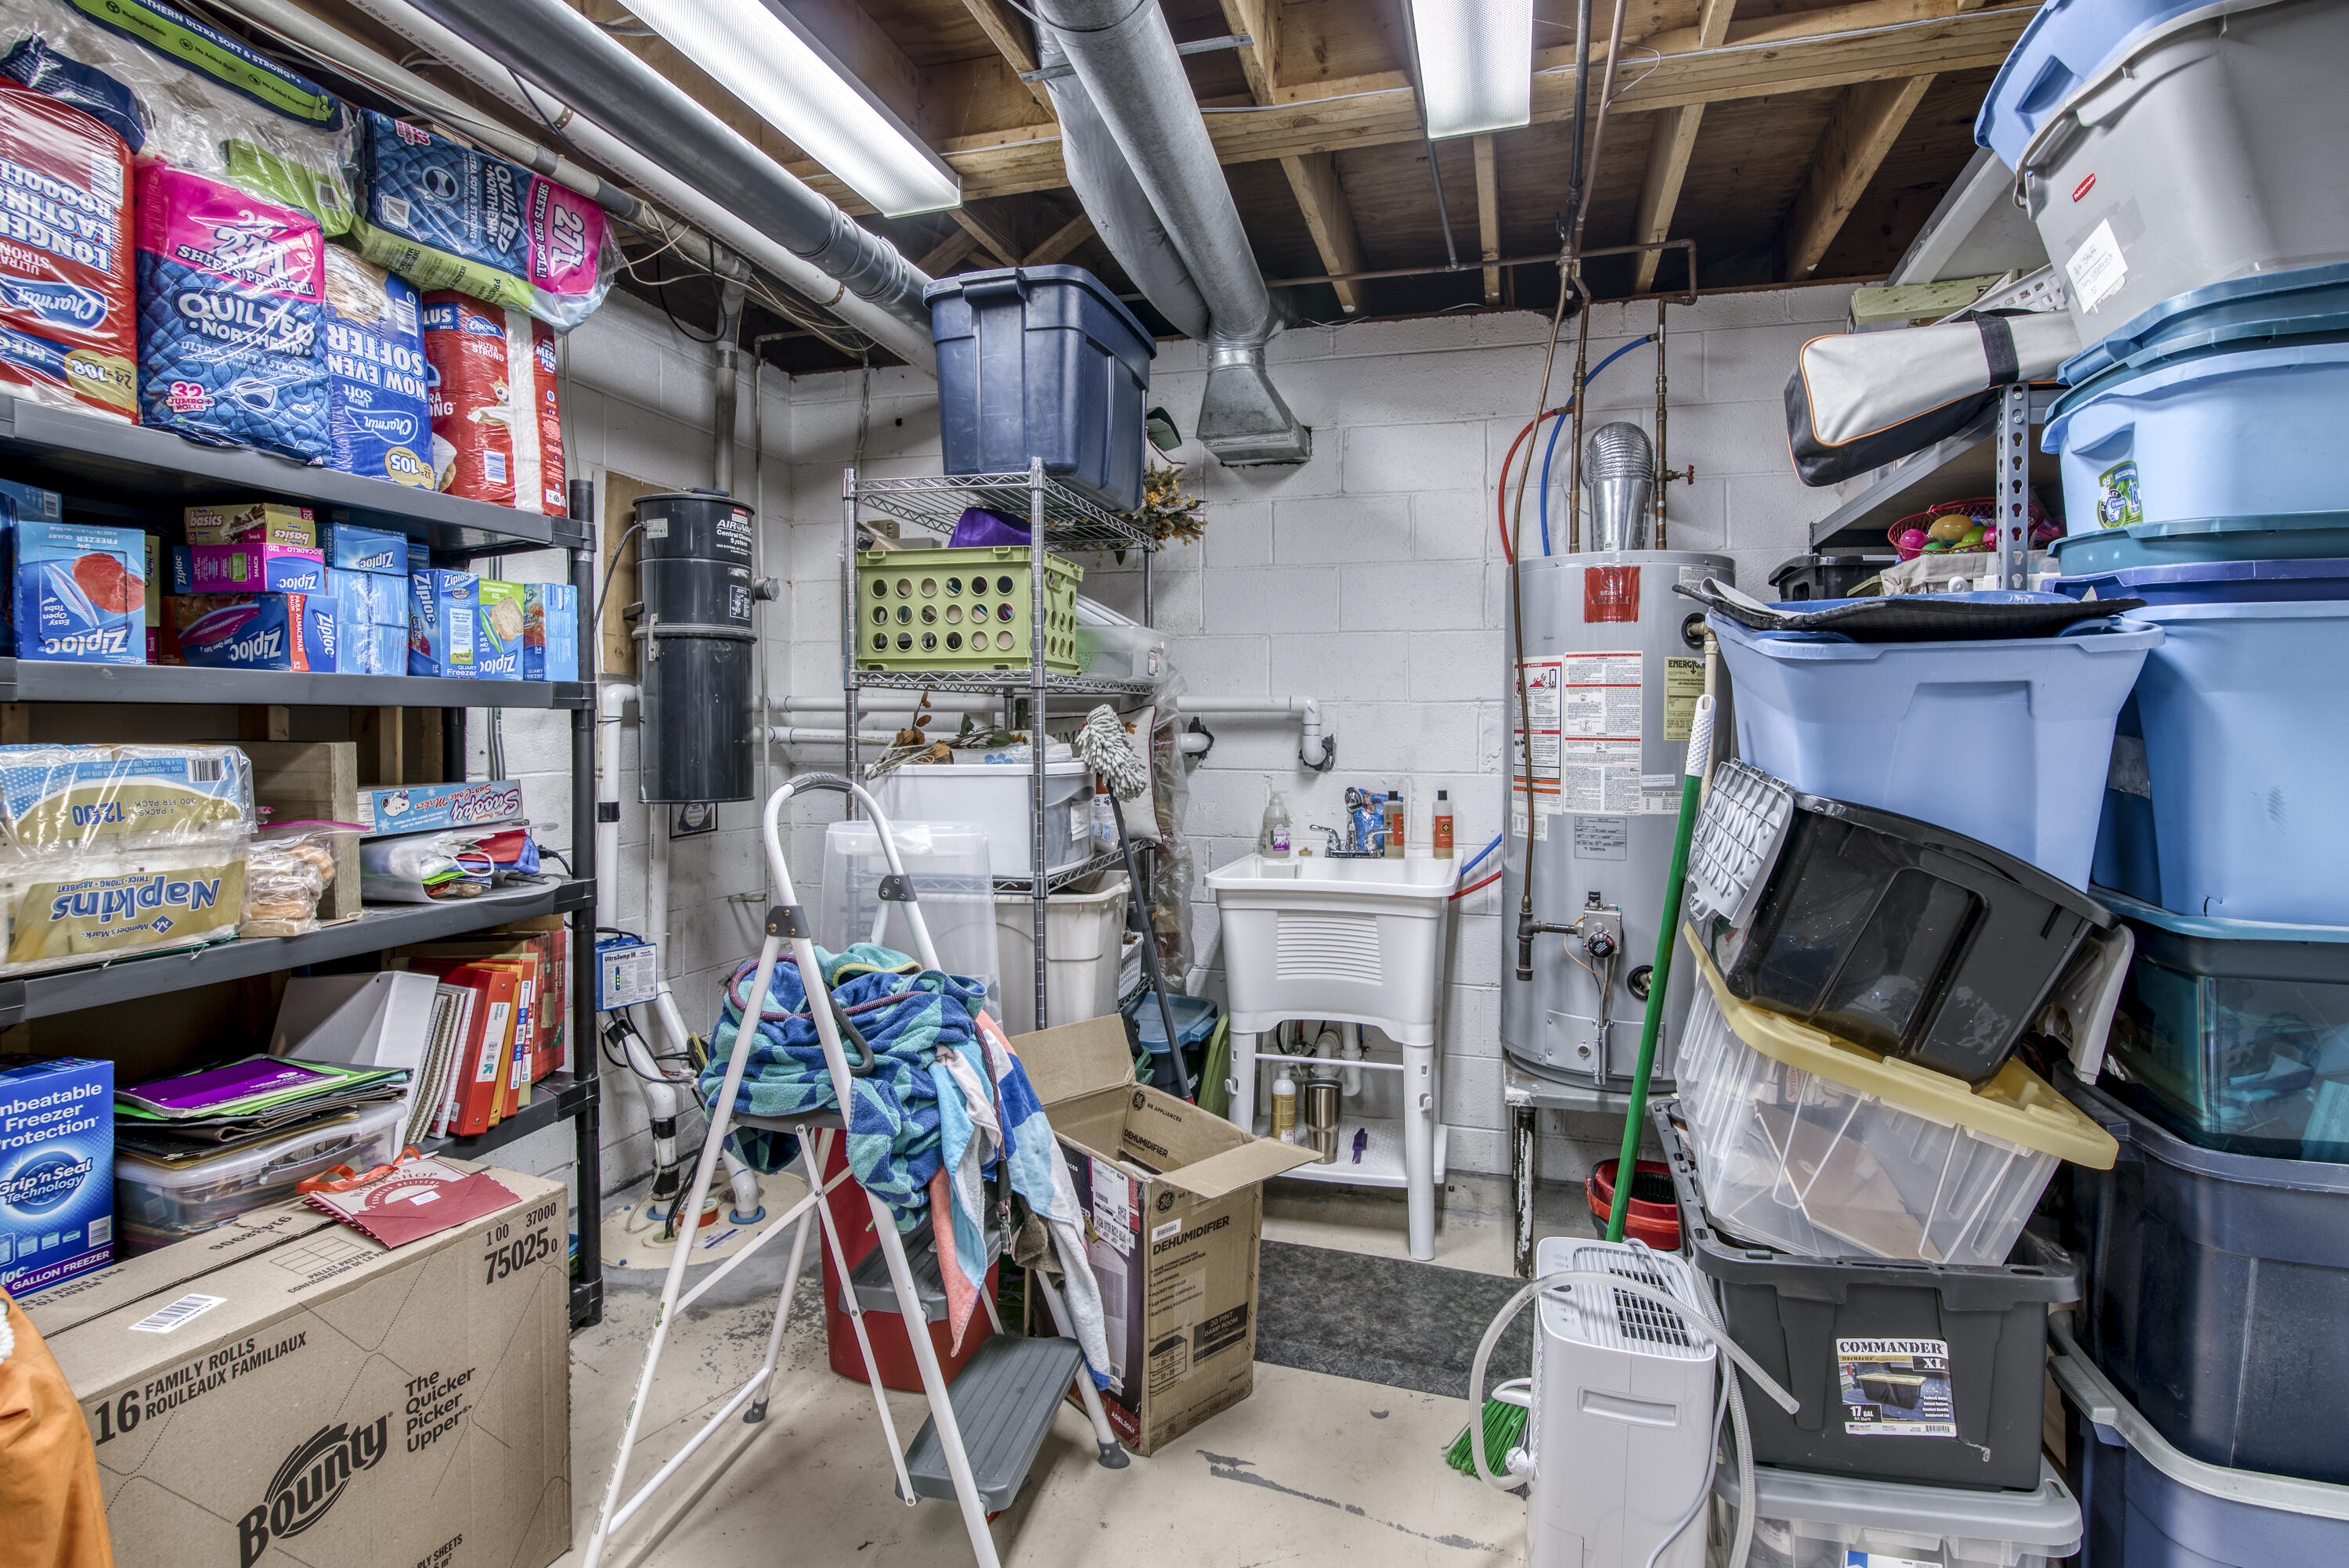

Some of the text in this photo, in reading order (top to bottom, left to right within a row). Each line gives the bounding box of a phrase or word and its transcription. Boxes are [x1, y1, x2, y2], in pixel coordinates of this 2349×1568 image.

[121, 9, 167, 37] Biodegradable
[185, 19, 216, 40] ULTRA
[218, 36, 243, 54] SOFT
[194, 45, 222, 67] No Added
[413, 128, 430, 145] 32
[469, 153, 478, 175] ULTRA
[2073, 175, 2096, 199] Rubbermaid
[494, 165, 513, 254] QUILTED
[534, 182, 550, 279] SHEETS PER ROLL!
[551, 205, 584, 267] 271
[175, 244, 276, 289] SHEETS PER
[18, 288, 98, 322] Charmin
[178, 291, 315, 346] QUILTED
[469, 319, 497, 334] Charmin
[181, 341, 259, 364] ULTRA SOFT
[327, 321, 425, 377] SOFTER
[471, 344, 505, 362] STRONG
[477, 340, 498, 352] ULTRA
[73, 358, 109, 384] 108
[327, 353, 428, 402] NOW EVEN
[343, 384, 373, 402] Soft
[348, 397, 370, 409] Ultra
[363, 415, 412, 437] Charmin
[391, 453, 420, 474] 105
[2127, 482, 2140, 506] 18
[189, 510, 222, 528] basics
[75, 535, 119, 545] FREEZER
[273, 529, 311, 545] basics
[716, 529, 738, 539] Central
[730, 537, 748, 547] System
[287, 546, 323, 556] BOCADILLO
[359, 551, 394, 570] Ziploc
[175, 555, 188, 586] Ziploc
[278, 574, 317, 591] Ziploc
[444, 573, 470, 588] Ziploc
[413, 573, 435, 623] Ziploc
[44, 628, 128, 657] Ziploc
[212, 637, 234, 651] Easy Open
[295, 612, 304, 652] ALMACENAR
[315, 611, 336, 656] Ziploc
[229, 630, 282, 661] Ziploc
[293, 661, 301, 670] 52
[446, 668, 478, 676] Freezer
[414, 784, 492, 810] Sno-Cone Maker
[450, 789, 520, 822] Snoopy
[49, 876, 221, 923] Napkins
[110, 922, 149, 934] Member's
[604, 953, 630, 962] UltraSump
[5, 1105, 84, 1133] Freezer
[1154, 1105, 1182, 1123] APPLIANCES
[1123, 1128, 1169, 1159] DEHUMIDIFIER
[0, 1159, 92, 1196] Grip'n Seal
[5, 1176, 85, 1205] Technology
[371, 1179, 441, 1206] EXPRESS DELIVERY
[525, 1202, 557, 1228] 37000
[1153, 1215, 1230, 1256] DEHUMIDIFIER
[307, 1250, 374, 1280] PALLET PATTERN
[484, 1227, 549, 1286] 75025
[1165, 1256, 1189, 1268] CONNECTION
[1177, 1252, 1207, 1270] DRAIN OPTION
[11, 1250, 110, 1291] GALLON FREEZER
[287, 1256, 373, 1295] CONFIGURATION DE LA
[1156, 1272, 1179, 1286] FAN SPEEDS
[1151, 1290, 1203, 1317] EASY-ROLL WHEELS
[1152, 1287, 1167, 1297] POCKET
[1159, 1284, 1196, 1304] DIGITAL CONTROLS
[1203, 1316, 1239, 1339] DAMP ROOM
[1210, 1310, 1234, 1328] 20 PINT
[1839, 1340, 1943, 1355] COMMANDER
[145, 1337, 256, 1401] FAMILY ROLLS
[145, 1331, 307, 1421] ROULEAUX FAMILIAUX
[1923, 1357, 1946, 1370] XL
[405, 1370, 440, 1398] The
[405, 1367, 476, 1415] Quicker
[94, 1390, 141, 1447] 16
[406, 1392, 464, 1436] Picker
[1111, 1411, 1135, 1434] ADEL20LY
[1850, 1405, 1861, 1417] 17
[235, 1414, 389, 1568] Bounty
[433, 1534, 464, 1561] SHEETS
